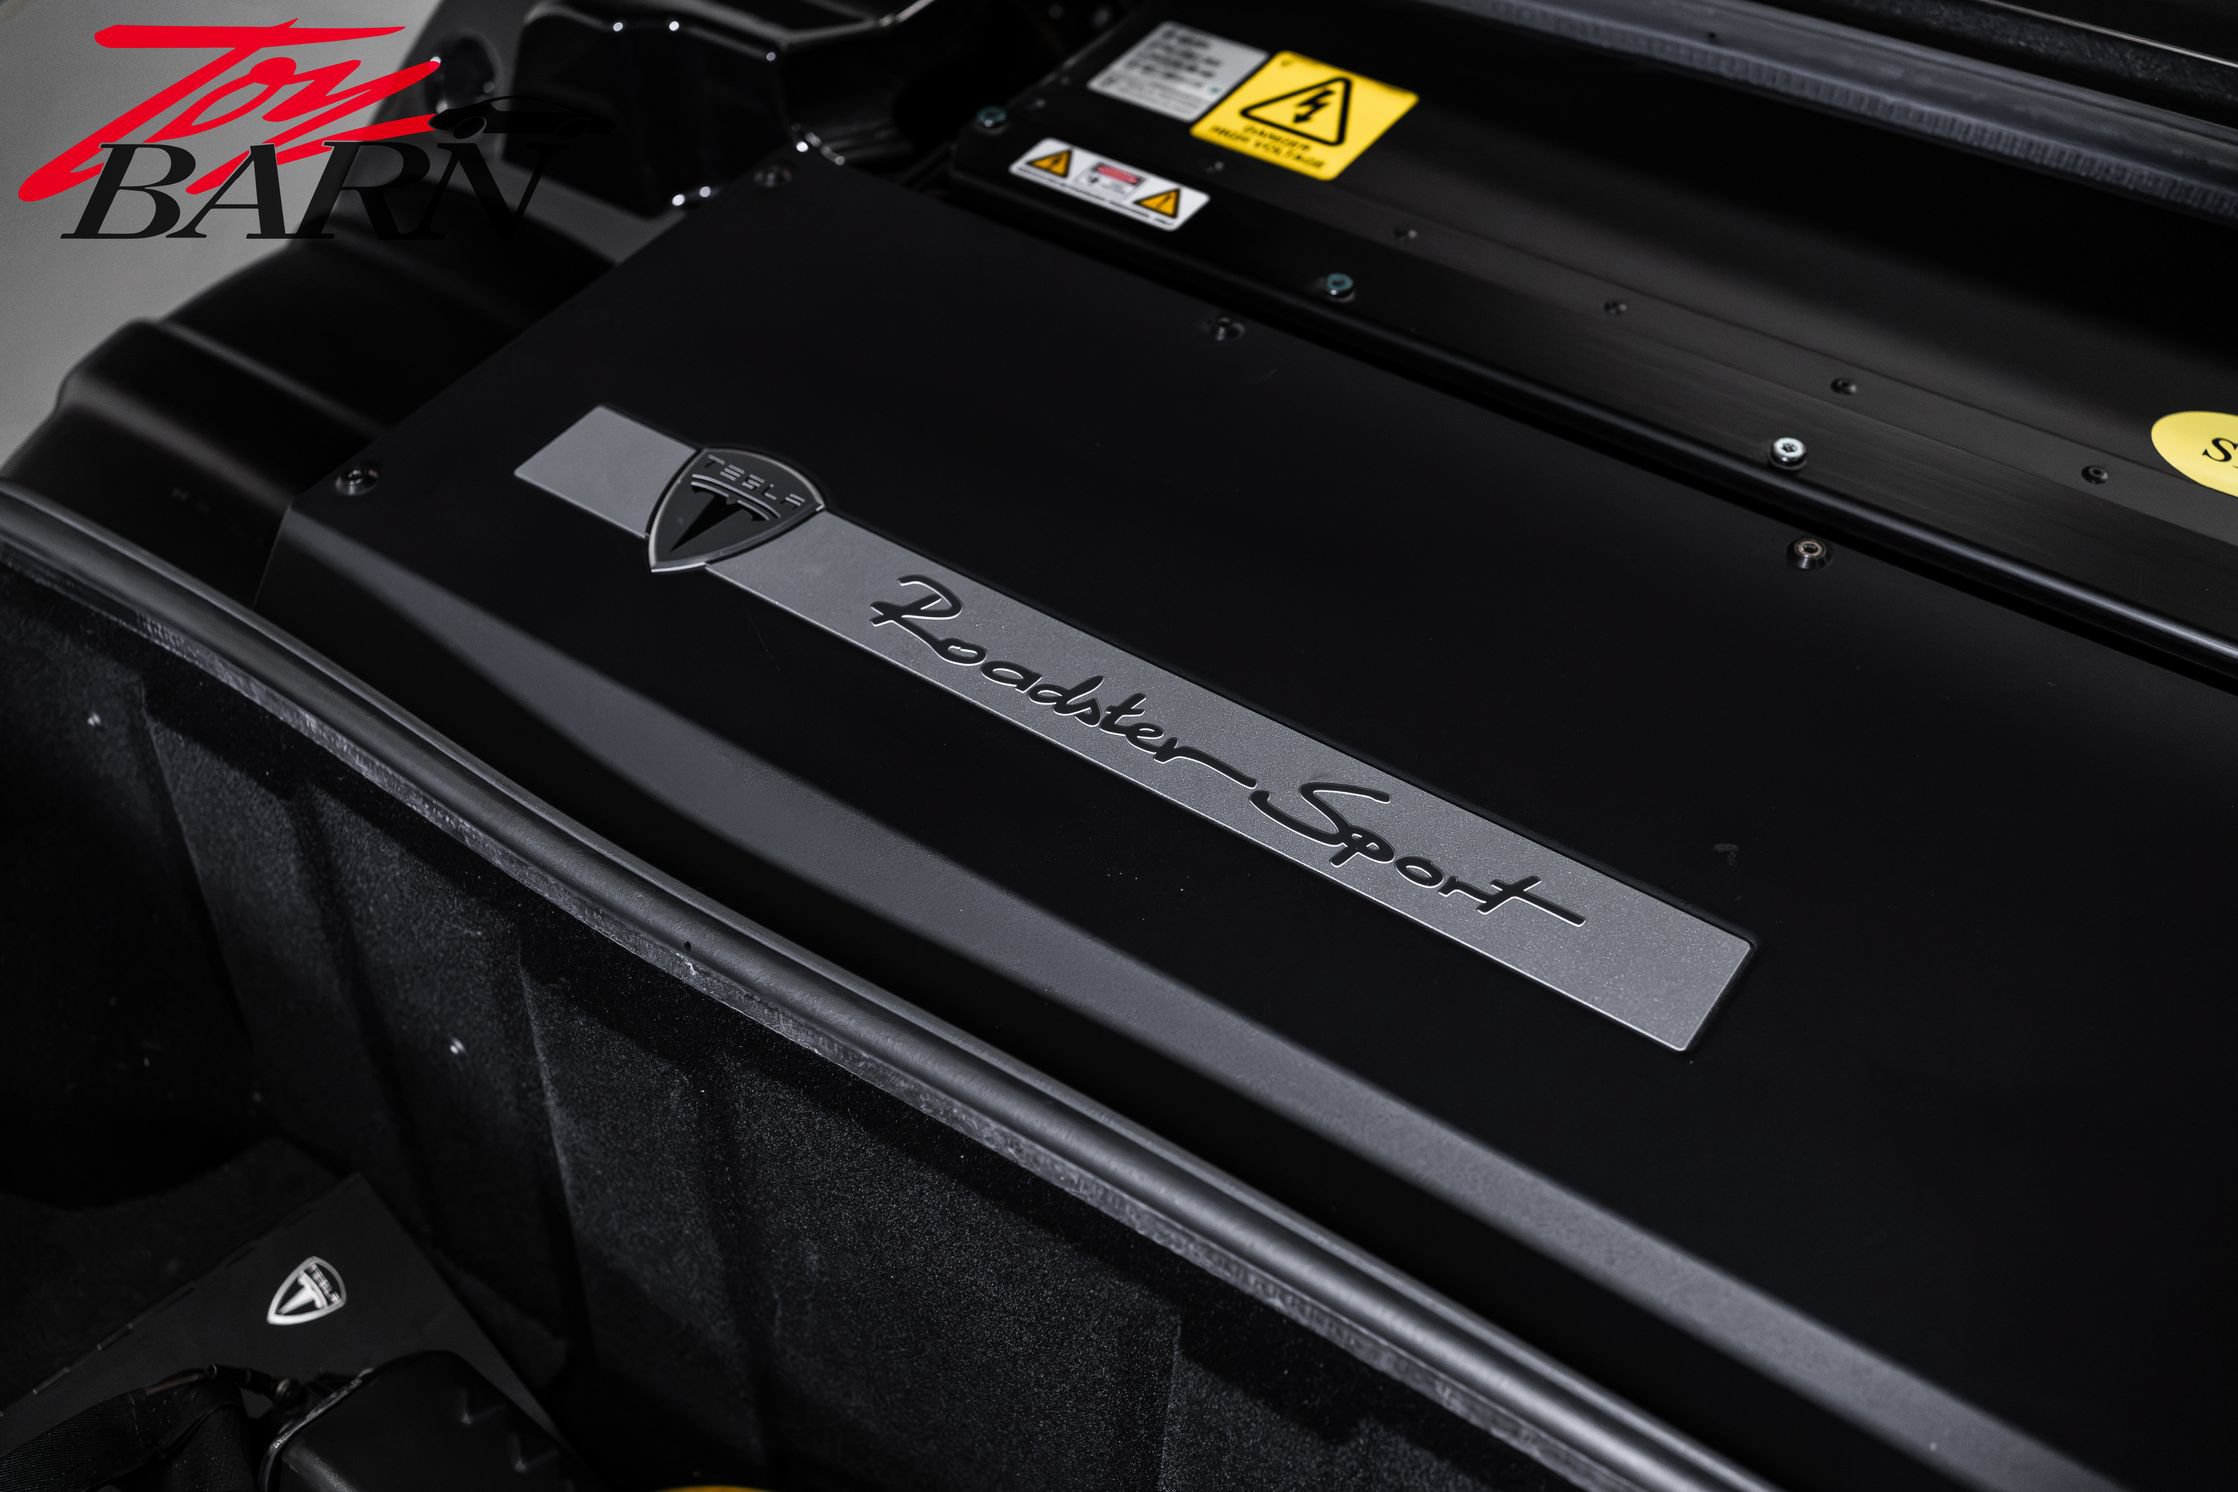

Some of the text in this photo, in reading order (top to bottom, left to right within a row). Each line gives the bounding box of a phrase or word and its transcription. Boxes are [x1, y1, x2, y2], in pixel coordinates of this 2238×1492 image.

[704, 453, 806, 511] TESLA
[2202, 437, 2238, 469] S
[869, 574, 1586, 926] Roadster Sport
